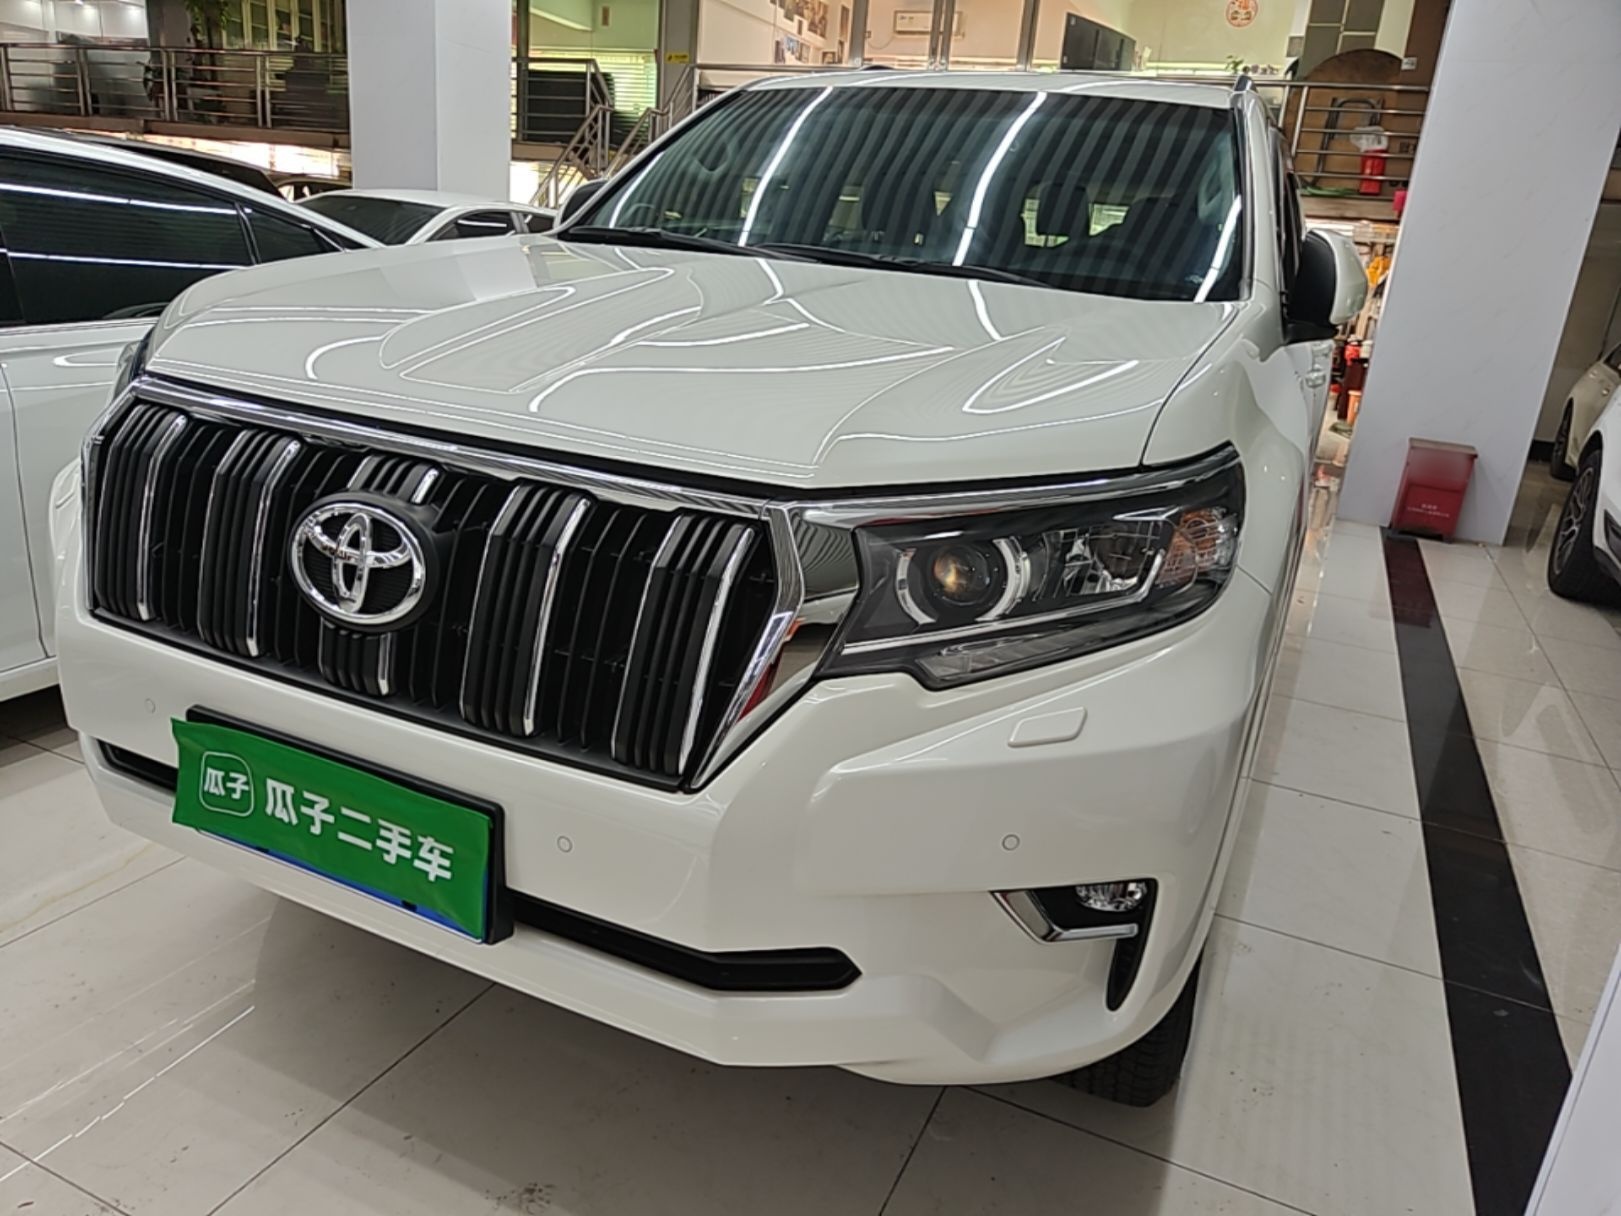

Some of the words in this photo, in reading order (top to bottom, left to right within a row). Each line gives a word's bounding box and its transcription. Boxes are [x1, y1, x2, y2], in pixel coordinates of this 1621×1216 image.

[204, 767, 249, 799] 瓜子
[265, 778, 454, 882] 瓜子二手车
